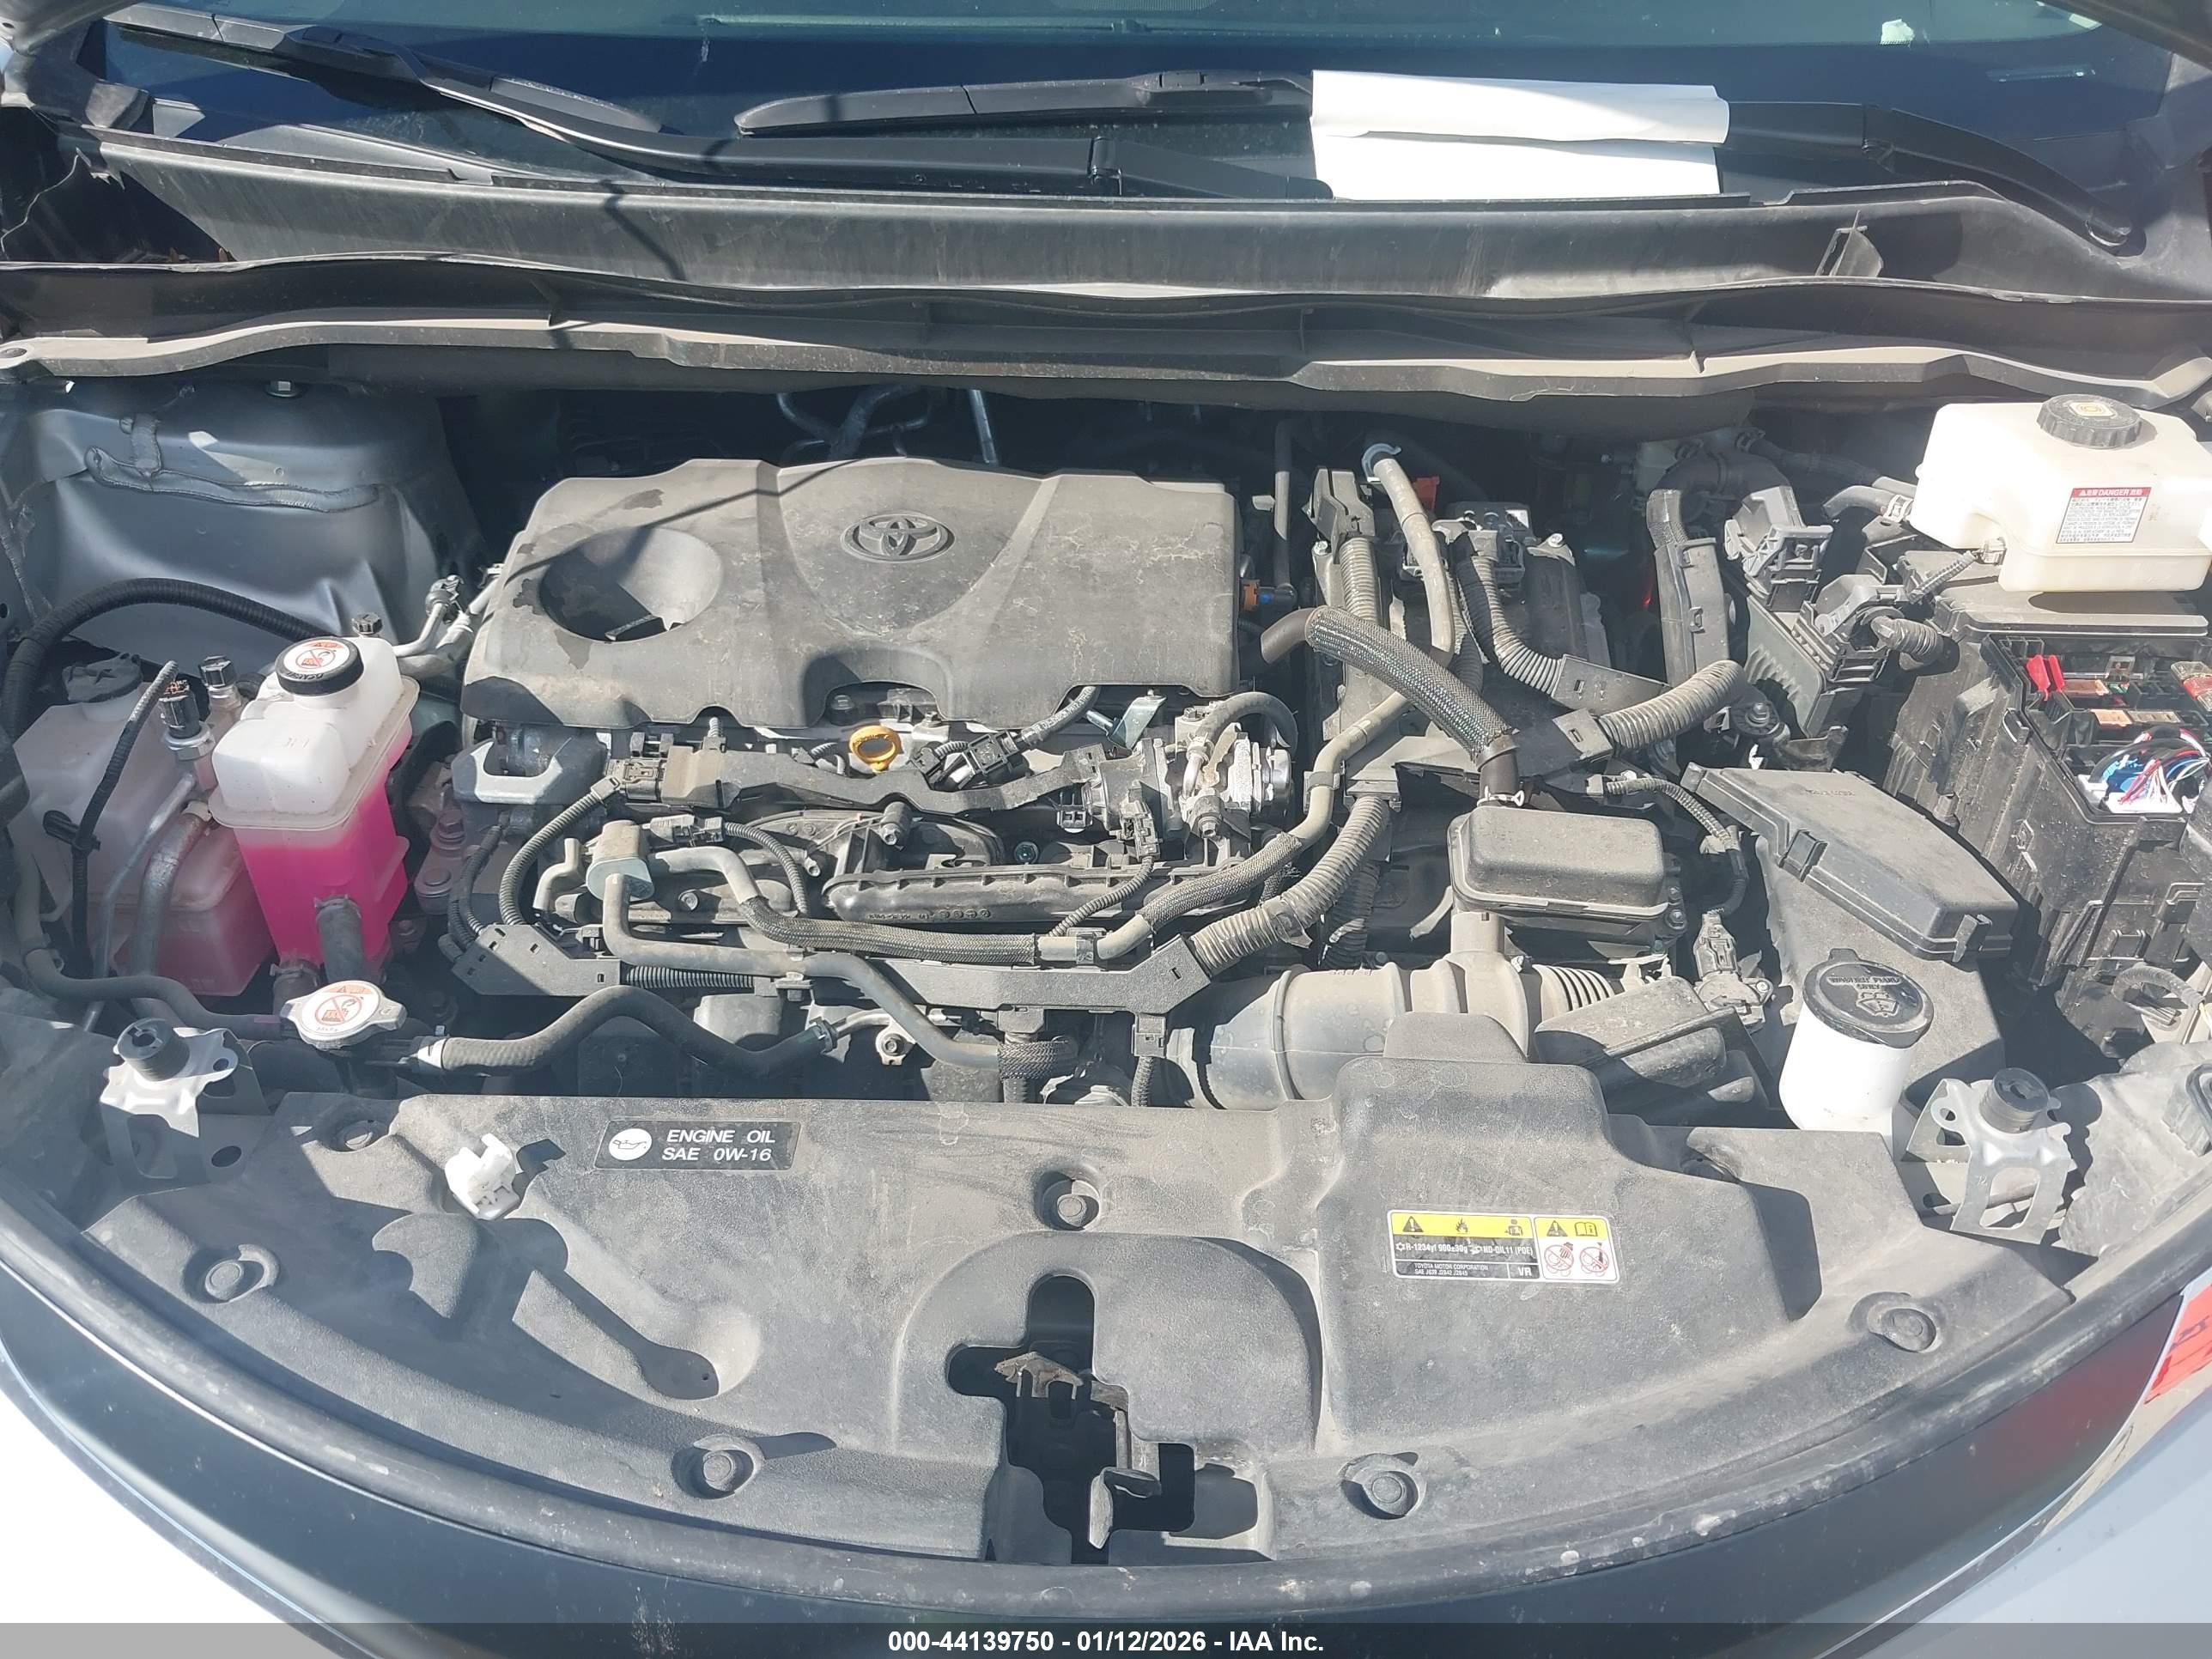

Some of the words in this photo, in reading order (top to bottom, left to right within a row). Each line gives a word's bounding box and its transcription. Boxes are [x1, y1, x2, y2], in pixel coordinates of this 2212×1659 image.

[666, 1129, 735, 1143] ENGINE
[746, 1129, 776, 1144] OIL
[661, 1147, 701, 1161] SAE
[714, 1148, 772, 1161] 0W-16
[1405, 1243, 1437, 1253] R-1234yf
[1438, 1243, 1468, 1254] 900±30g
[1515, 1246, 1534, 1256] (POE)
[1517, 1267, 1533, 1277] VR
